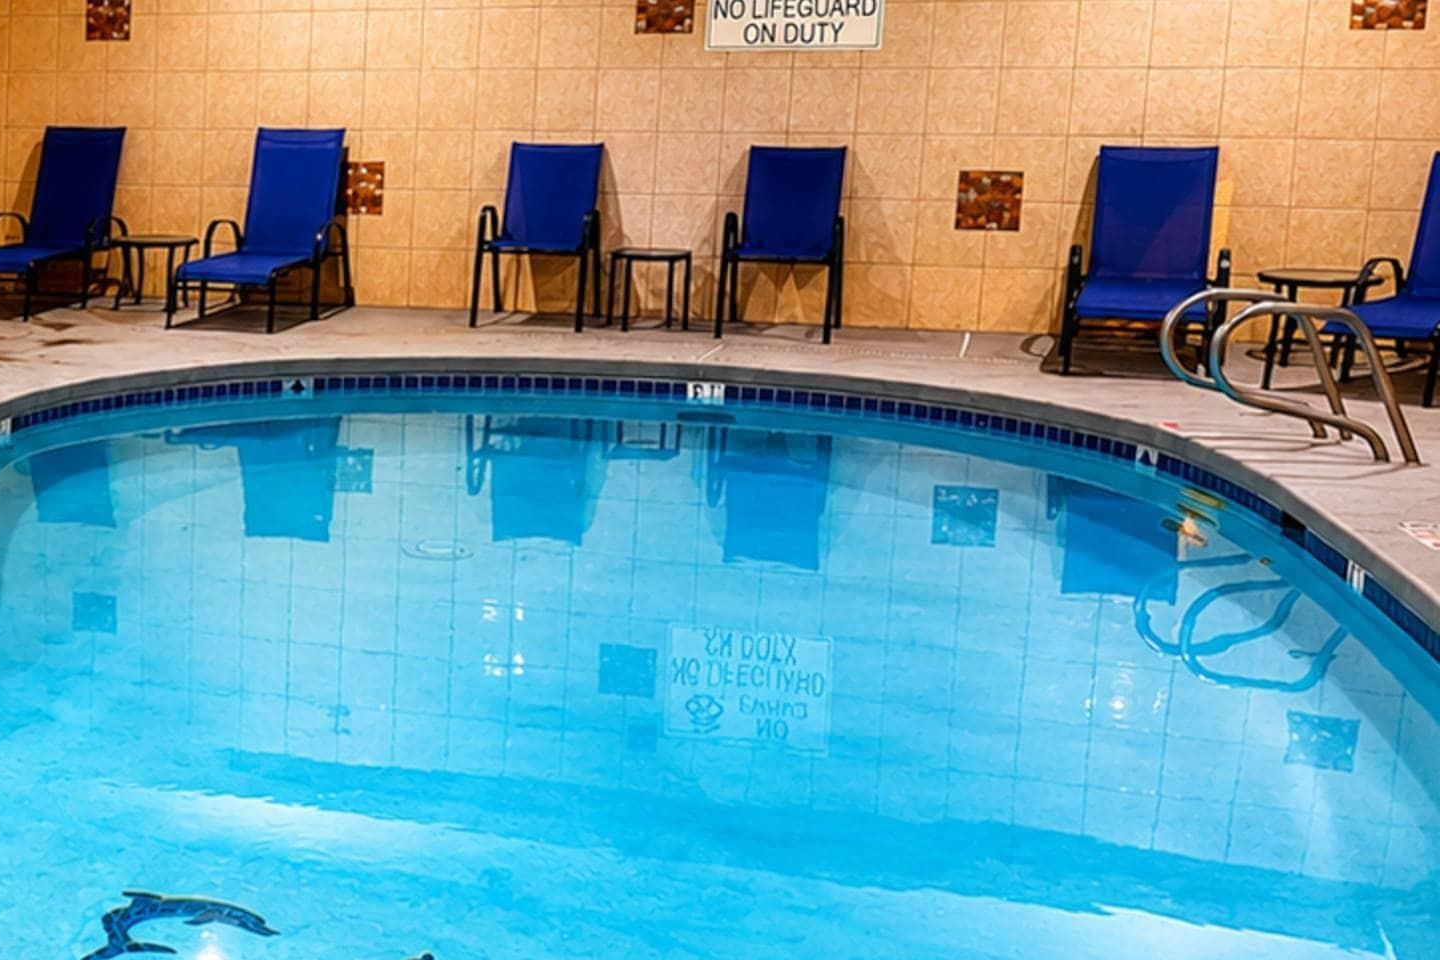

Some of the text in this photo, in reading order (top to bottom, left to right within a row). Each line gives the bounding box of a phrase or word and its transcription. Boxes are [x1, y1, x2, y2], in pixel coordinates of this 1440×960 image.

[713, 0, 876, 19] NO LIFEGUARD
[743, 22, 844, 45] ON DUTY
